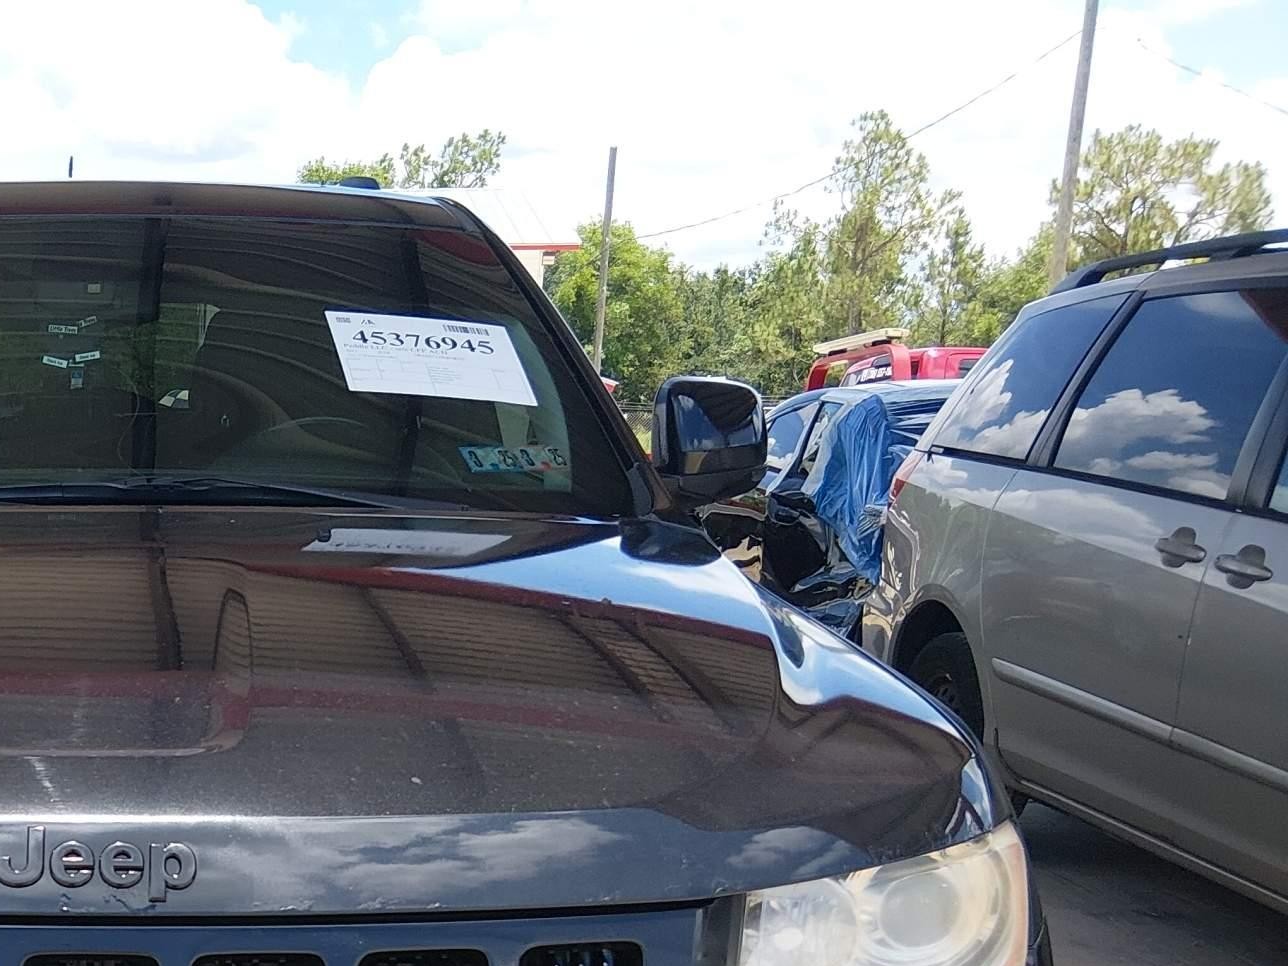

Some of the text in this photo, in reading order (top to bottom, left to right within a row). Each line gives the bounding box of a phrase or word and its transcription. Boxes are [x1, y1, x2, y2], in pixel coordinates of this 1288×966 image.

[353, 329, 494, 355] 45376945
[467, 450, 483, 468] 3
[520, 449, 535, 467] 3
